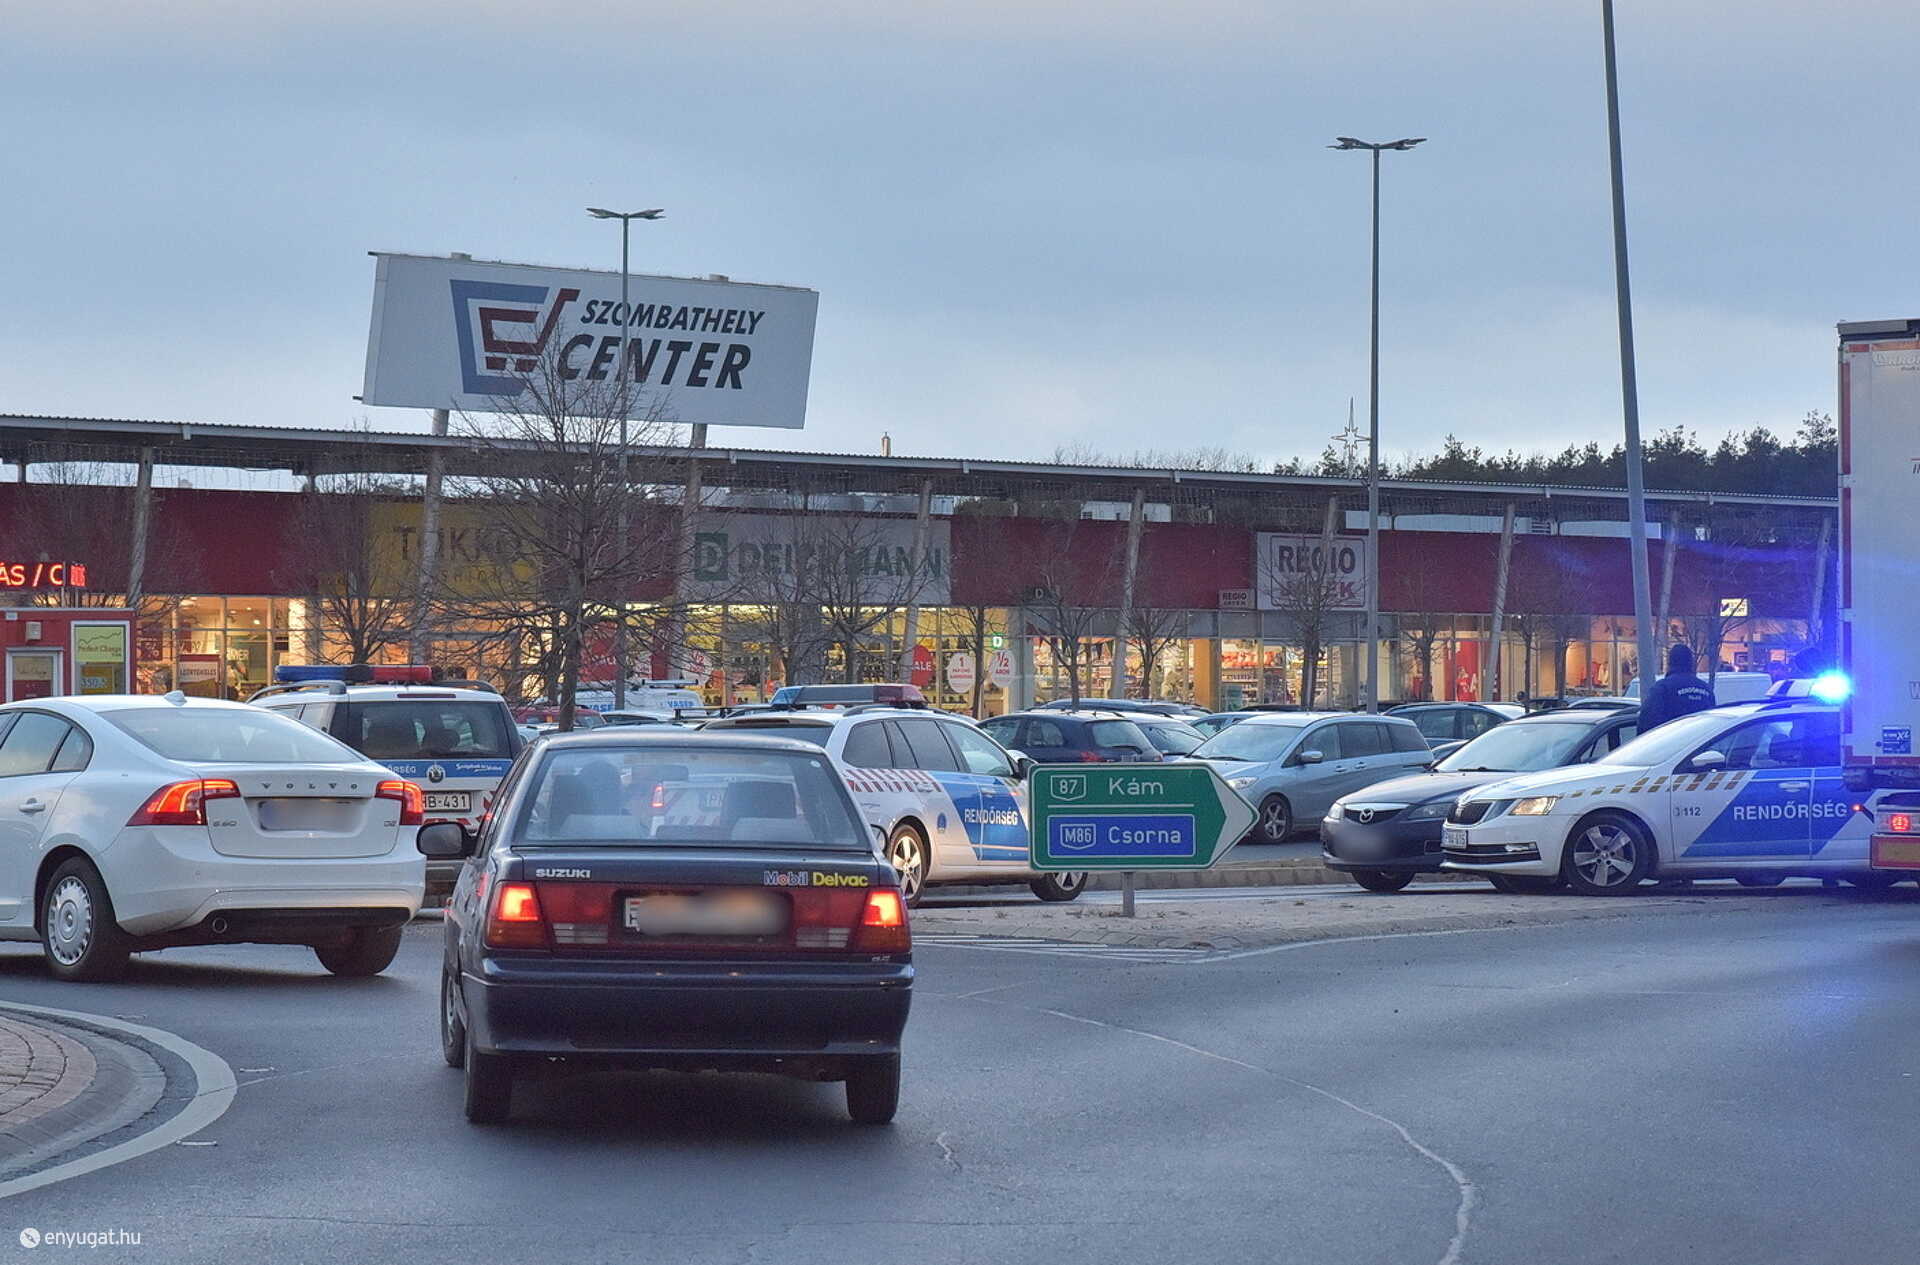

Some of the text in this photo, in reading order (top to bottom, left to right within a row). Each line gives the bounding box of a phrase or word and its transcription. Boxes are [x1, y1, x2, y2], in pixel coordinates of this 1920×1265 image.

[580, 299, 766, 335] SZOMBATHELY
[556, 333, 752, 390] CENTER
[1278, 545, 1356, 574] REGIO
[913, 661, 933, 672] ALE
[261, 782, 358, 790] VOLVO
[1059, 777, 1164, 796] 87 Kám
[964, 807, 1019, 827] RENDŐRSÉG
[1733, 800, 1848, 822] RENDŐRSÉG
[1065, 826, 1182, 845] M86 Csorna
[535, 868, 591, 880] SUZUKI
[764, 870, 868, 888] Mobil Delvac
